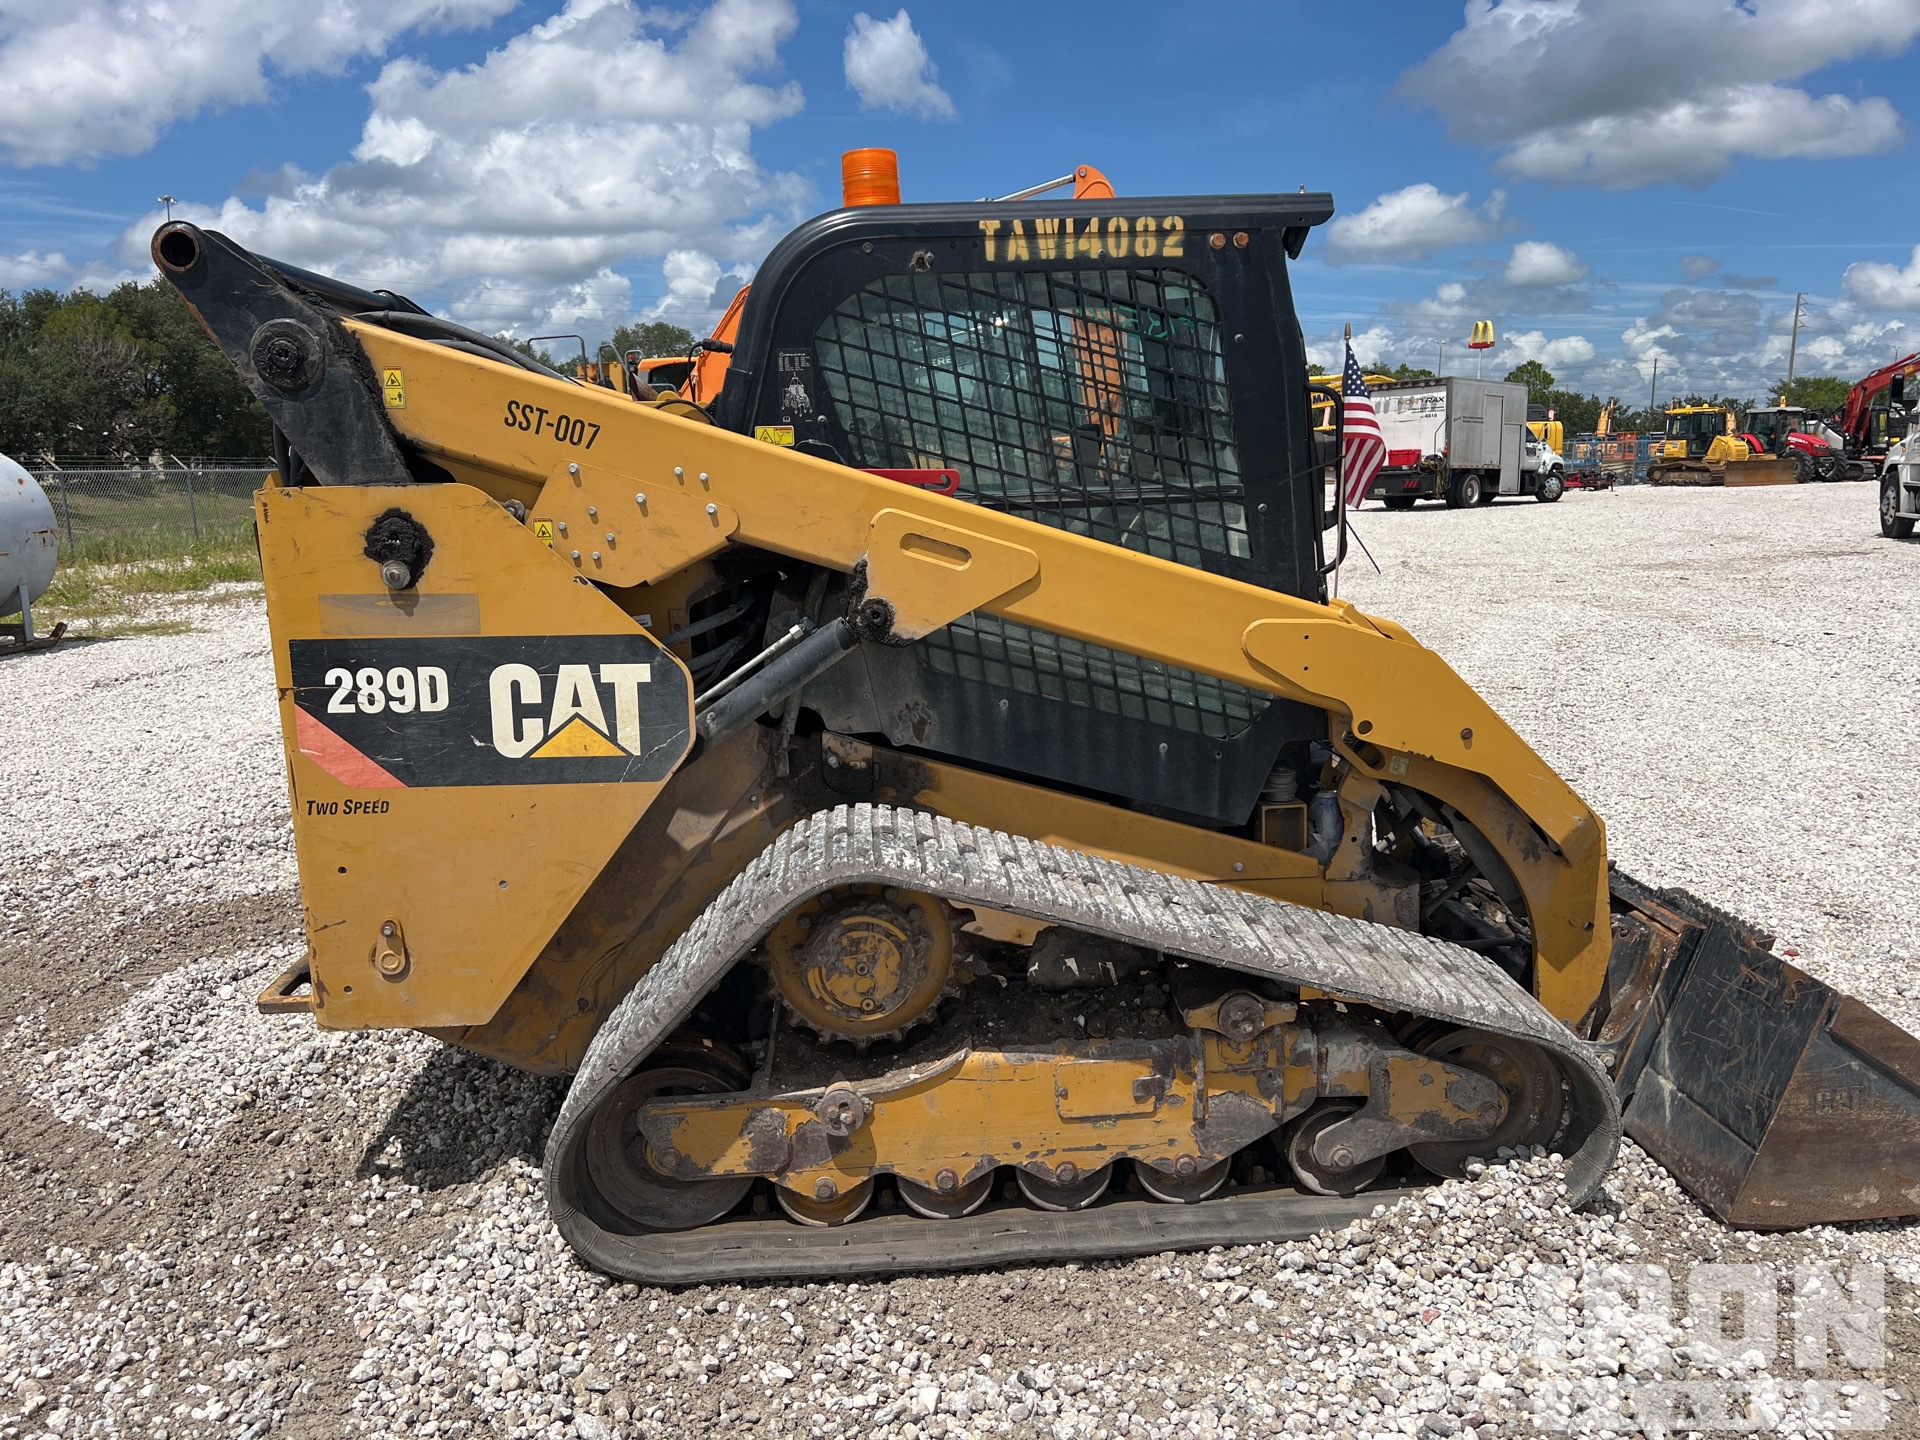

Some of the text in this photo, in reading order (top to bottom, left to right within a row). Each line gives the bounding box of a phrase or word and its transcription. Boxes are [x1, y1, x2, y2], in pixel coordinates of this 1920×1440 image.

[504, 400, 601, 449] SST-007
[324, 663, 651, 758] 289D CAT
[1815, 1083, 1864, 1117] CAT
